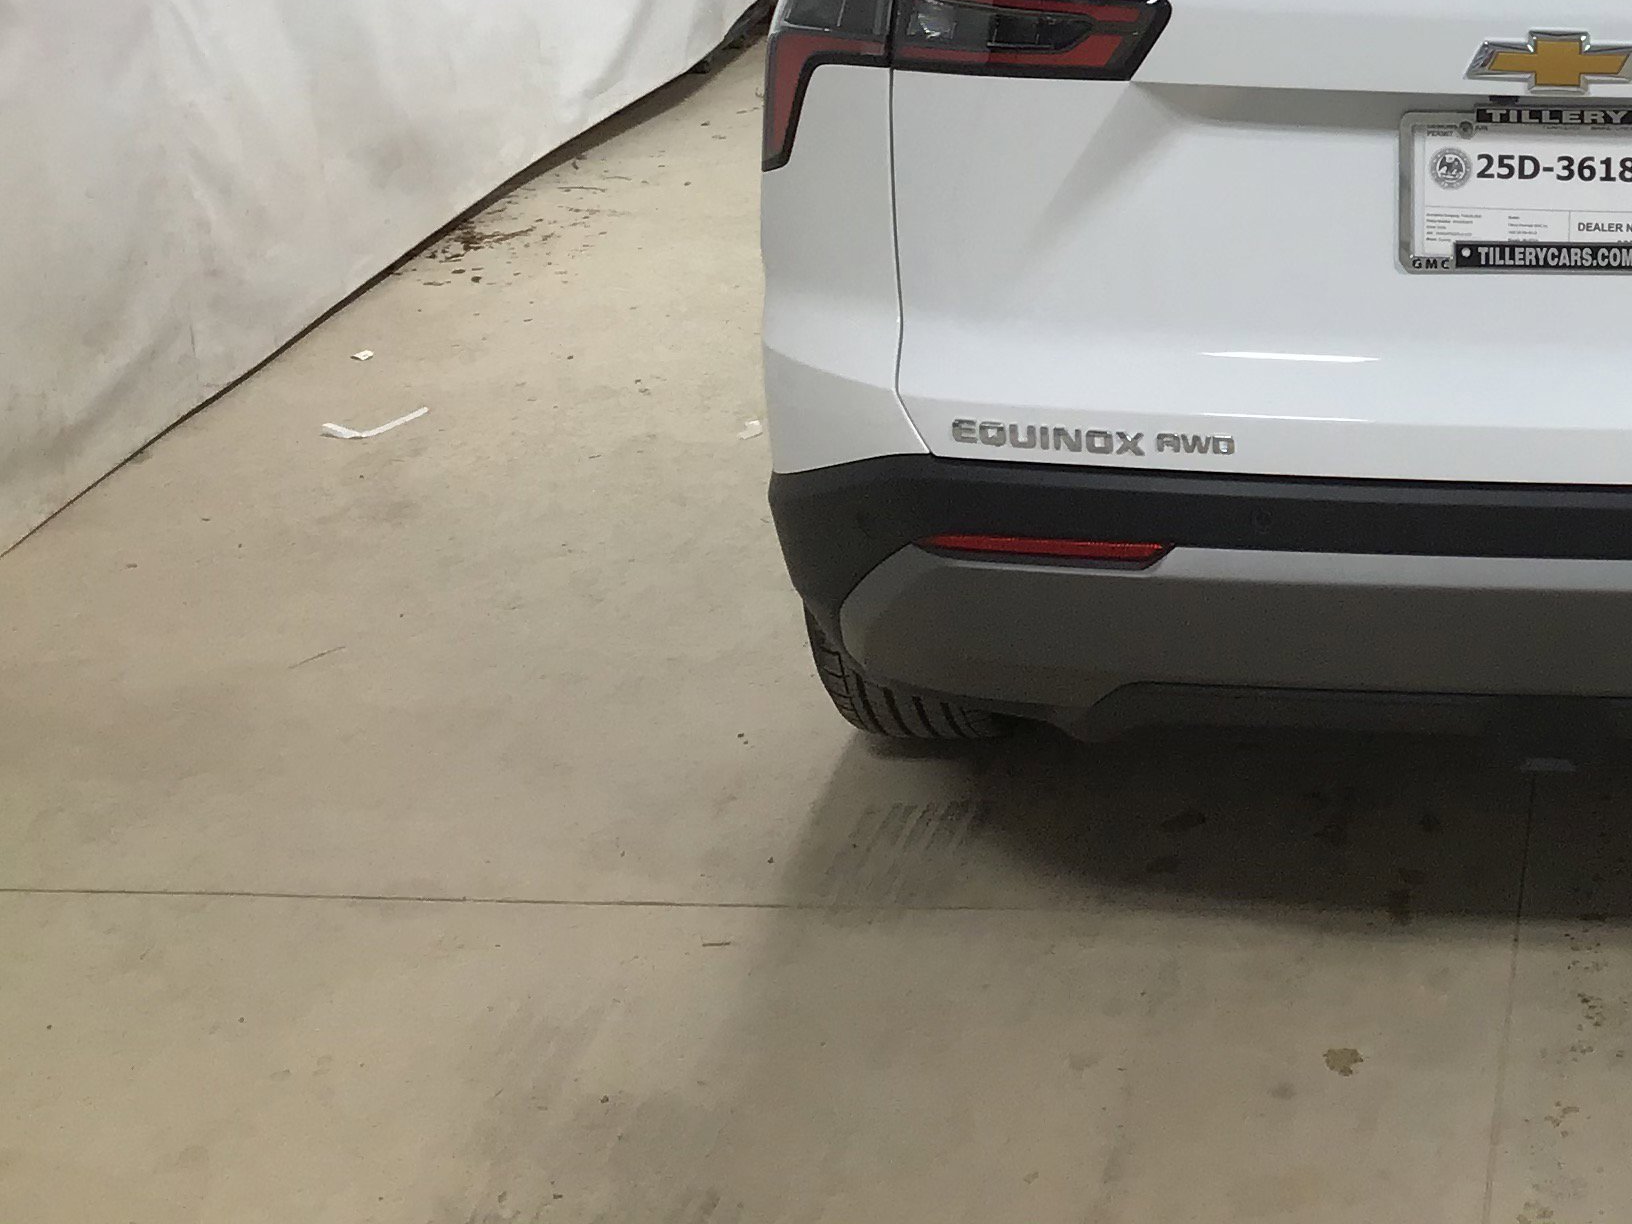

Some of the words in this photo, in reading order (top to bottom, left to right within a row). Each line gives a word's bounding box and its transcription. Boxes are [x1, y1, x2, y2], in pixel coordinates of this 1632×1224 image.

[1486, 108, 1629, 124] TILLERY
[1577, 222, 1624, 233] DEALER
[1412, 257, 1450, 270] GMC
[951, 418, 1146, 456] EQUINOX
[1156, 431, 1236, 455] AWD
